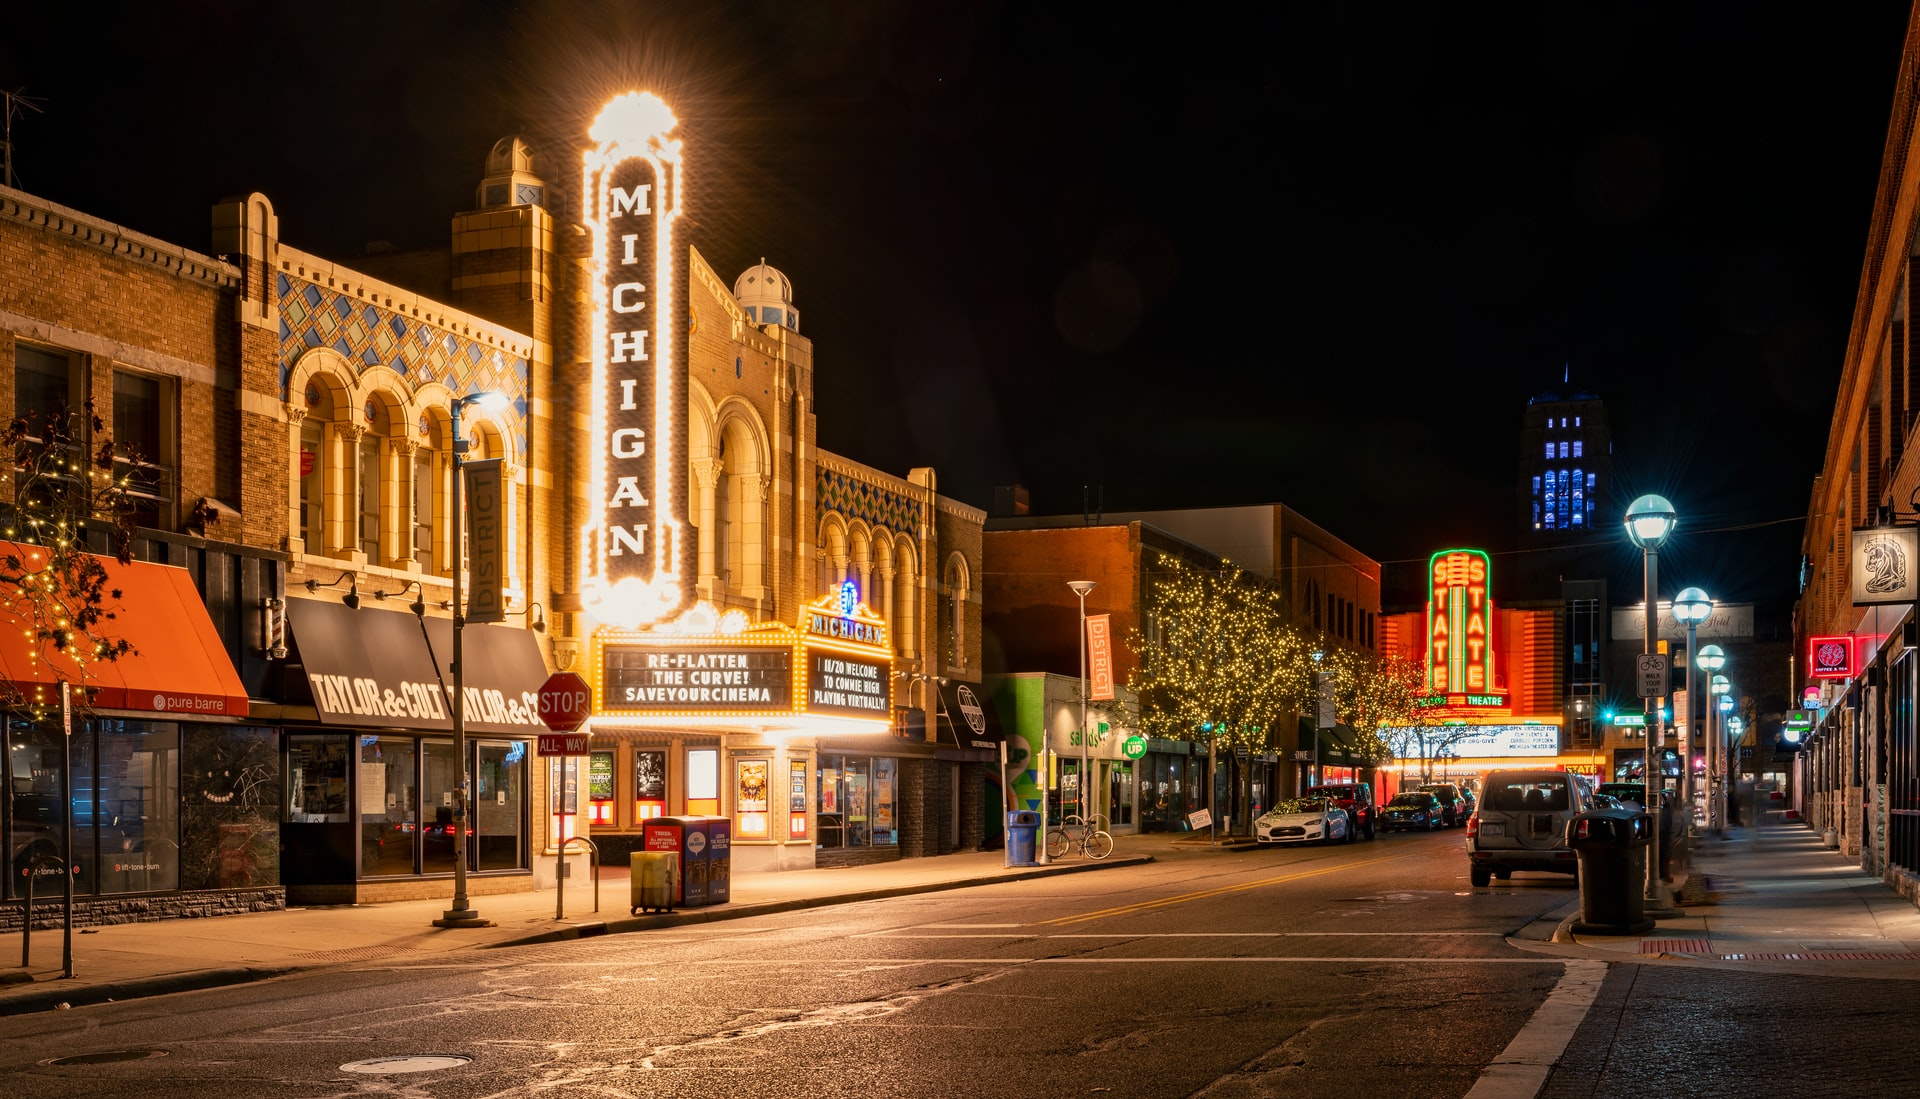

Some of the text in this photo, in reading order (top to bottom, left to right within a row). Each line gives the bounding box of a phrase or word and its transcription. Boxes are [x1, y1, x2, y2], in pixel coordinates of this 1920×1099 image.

[609, 183, 652, 557] MICHIGAN
[474, 476, 494, 607] DISTRICT
[811, 614, 883, 645] MICHIGAN
[1433, 561, 1449, 689] STATE
[1467, 560, 1485, 688] STATE
[1701, 615, 1731, 630] Hotel
[648, 654, 748, 669] RE-FLATTEN
[1092, 623, 1109, 692] DISTRICT
[824, 658, 877, 678] 11/20 WELCOME
[654, 671, 749, 685] THE CURVE!
[824, 675, 833, 689] TO
[863, 679, 880, 694] HIGH
[167, 696, 224, 711] pure barre
[540, 691, 586, 713] STOP
[626, 688, 771, 702] SAVEYOURCINEMA
[814, 689, 846, 706] PLAYING
[1467, 695, 1503, 706] THEATRE
[565, 738, 586, 752] WAY
[1127, 744, 1143, 754] UP
[1565, 764, 1597, 774] STATE
